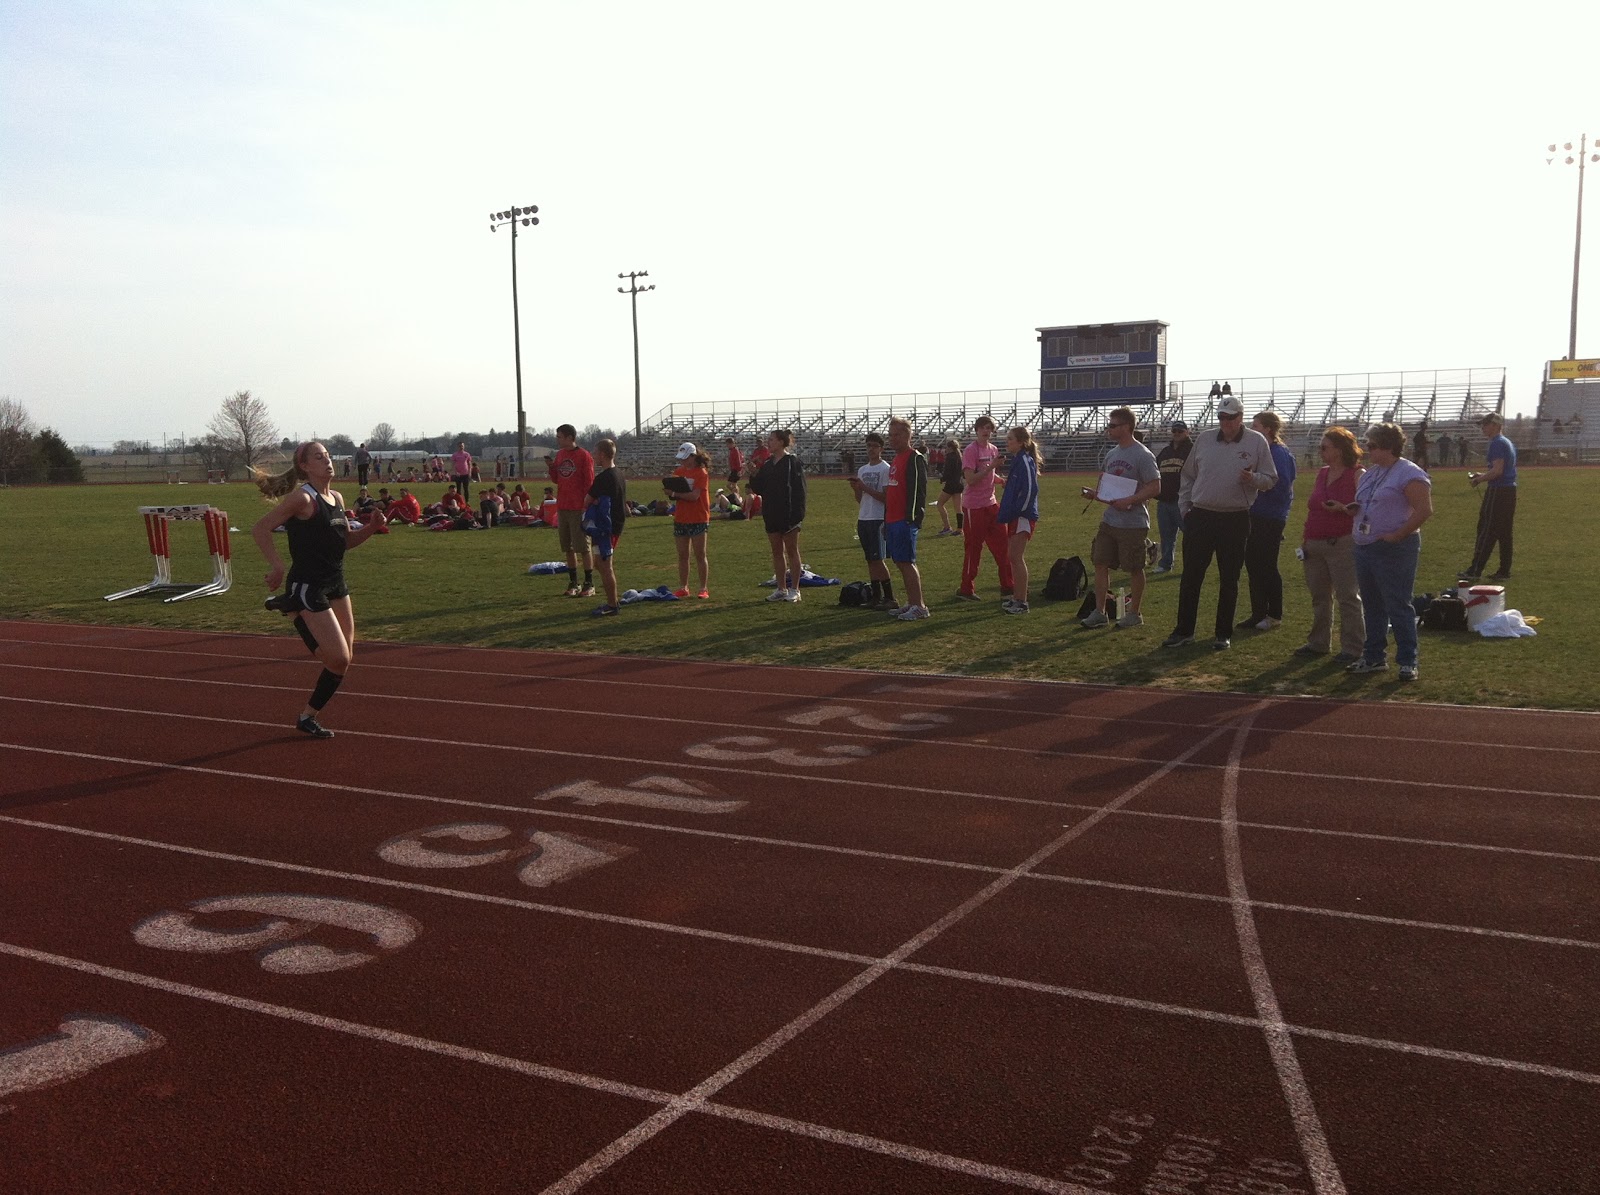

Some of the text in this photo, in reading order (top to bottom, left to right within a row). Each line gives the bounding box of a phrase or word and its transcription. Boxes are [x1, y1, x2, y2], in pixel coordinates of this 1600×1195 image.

[786, 705, 953, 733] 2
[685, 735, 872, 768] 3
[534, 776, 749, 815] 4
[377, 822, 636, 888] 5
[132, 894, 423, 975] 6
[1063, 1110, 1156, 1185] 3200
